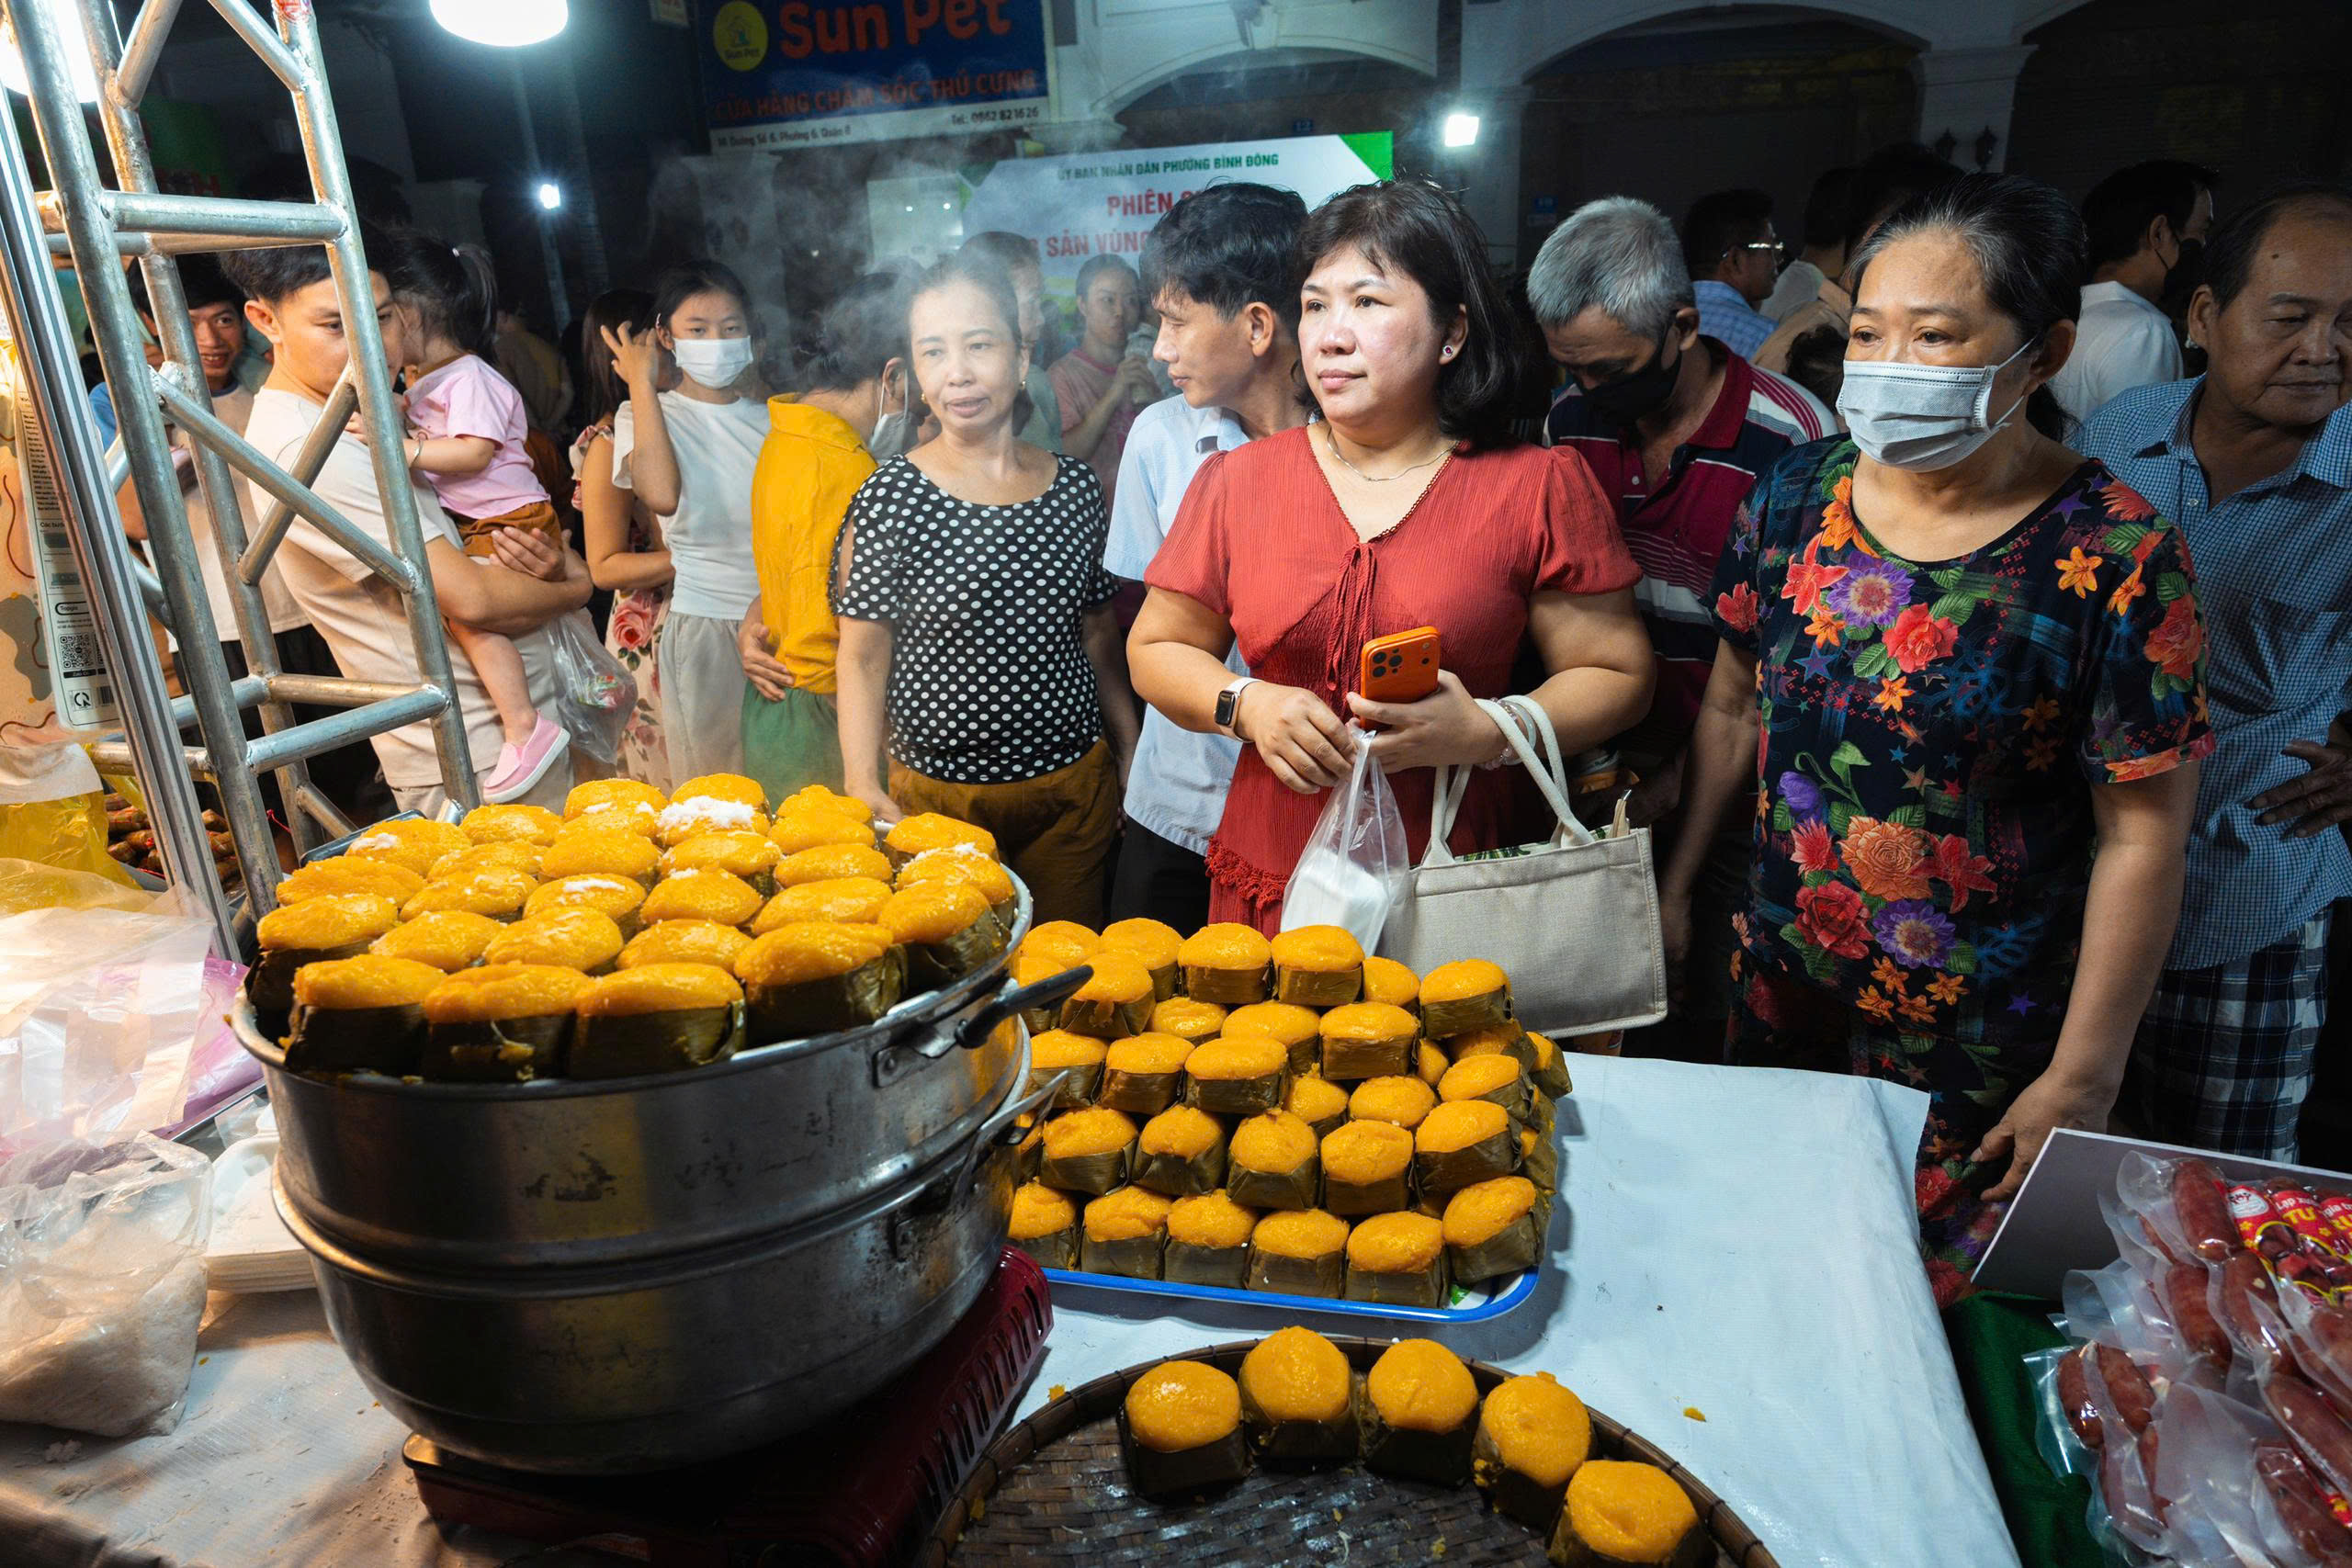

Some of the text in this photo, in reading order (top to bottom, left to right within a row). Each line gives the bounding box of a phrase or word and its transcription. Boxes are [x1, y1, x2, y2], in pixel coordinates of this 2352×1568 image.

[779, 0, 1012, 59] Sun Pet
[757, 87, 809, 114] HÀNG
[879, 74, 921, 104] SÓC
[1136, 160, 1159, 175] DÂN
[1163, 155, 1211, 173] PHƯỜNG
[1214, 153, 1242, 169] BÌNH
[1107, 187, 1173, 217] PHIÊN
[1046, 229, 1090, 258] SẢN
